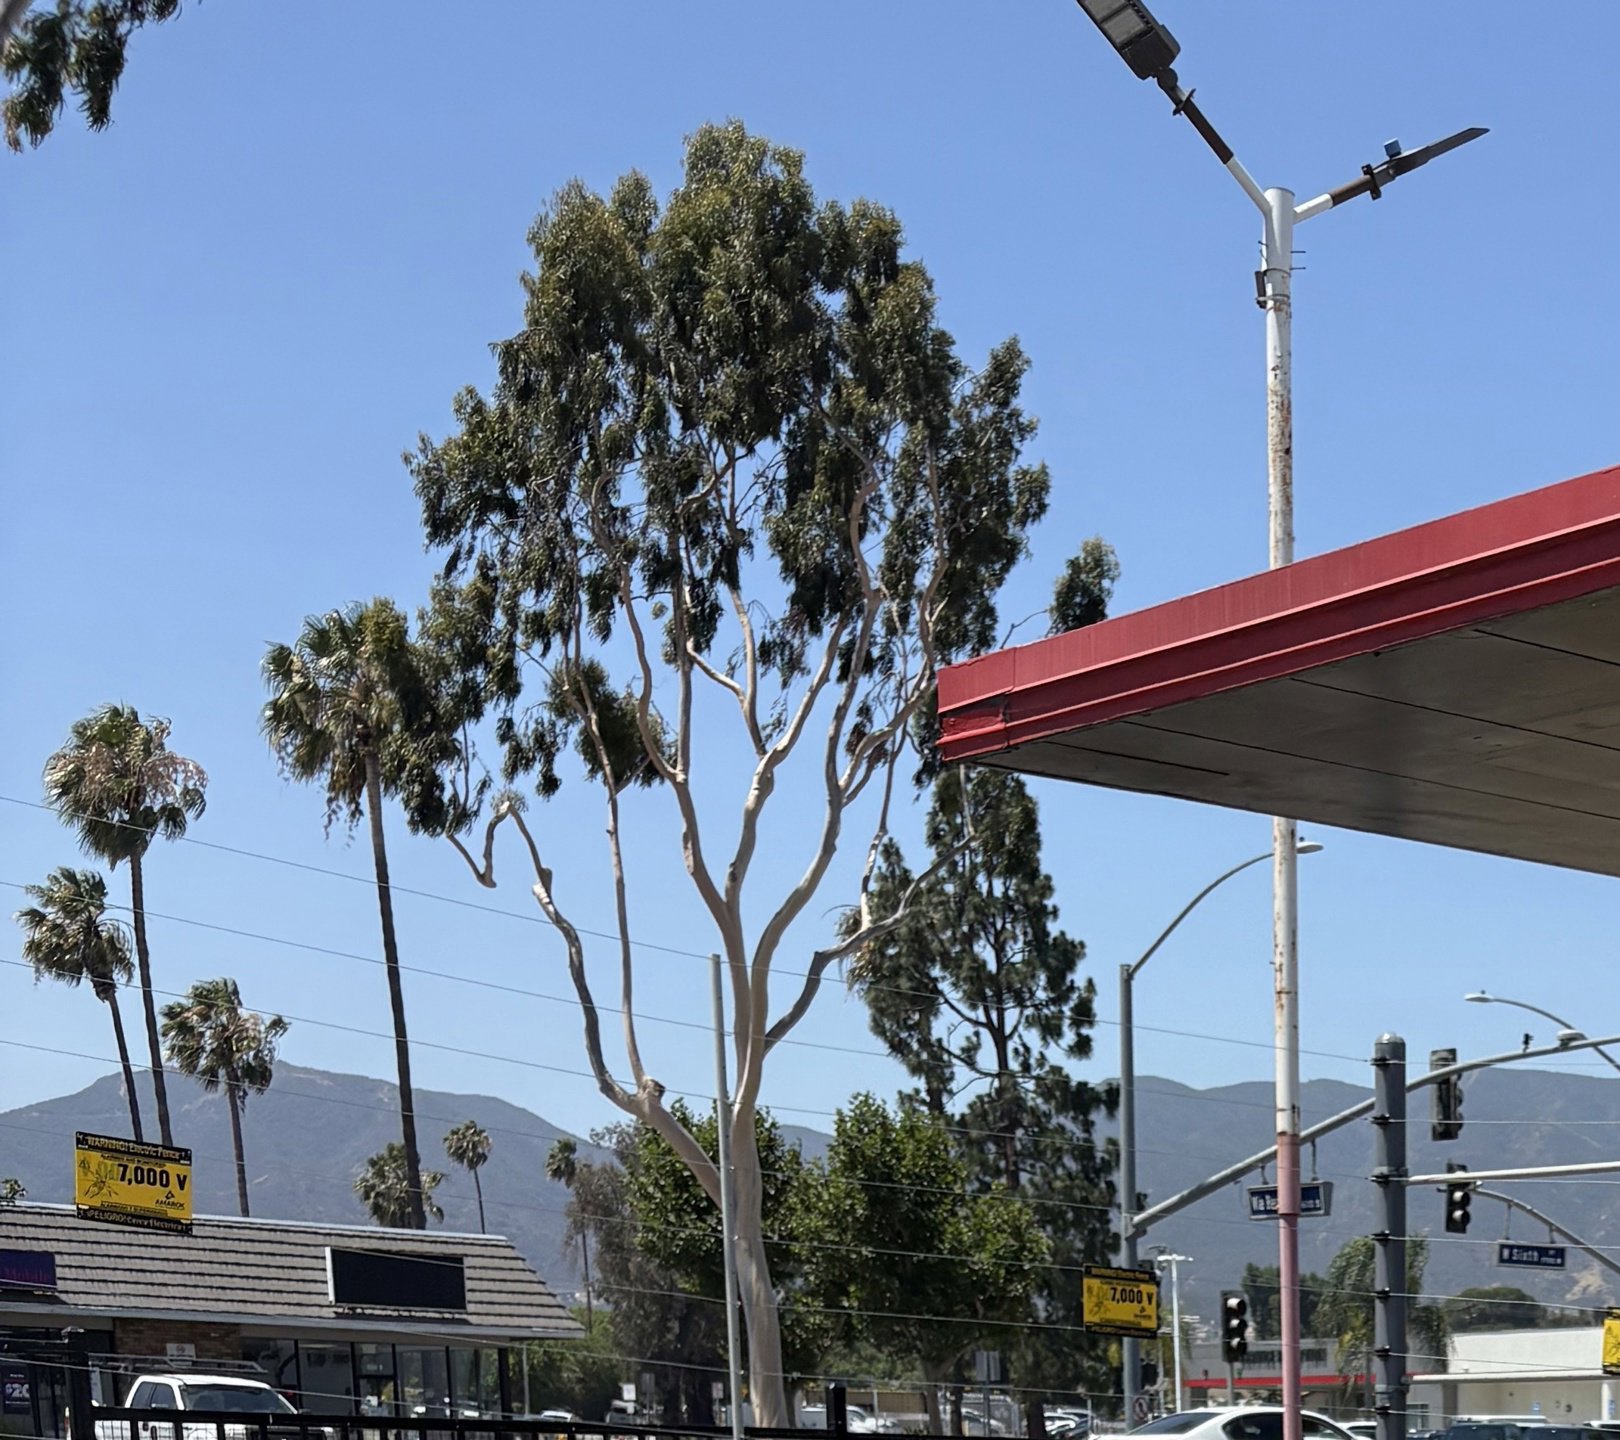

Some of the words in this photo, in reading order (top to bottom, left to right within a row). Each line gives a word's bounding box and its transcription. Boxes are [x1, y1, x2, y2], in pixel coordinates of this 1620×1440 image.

[118, 1163, 170, 1188] 7,000
[176, 1173, 188, 1191] V
[1110, 1287, 1143, 1304] 7,000
[1147, 1292, 1154, 1306] V
